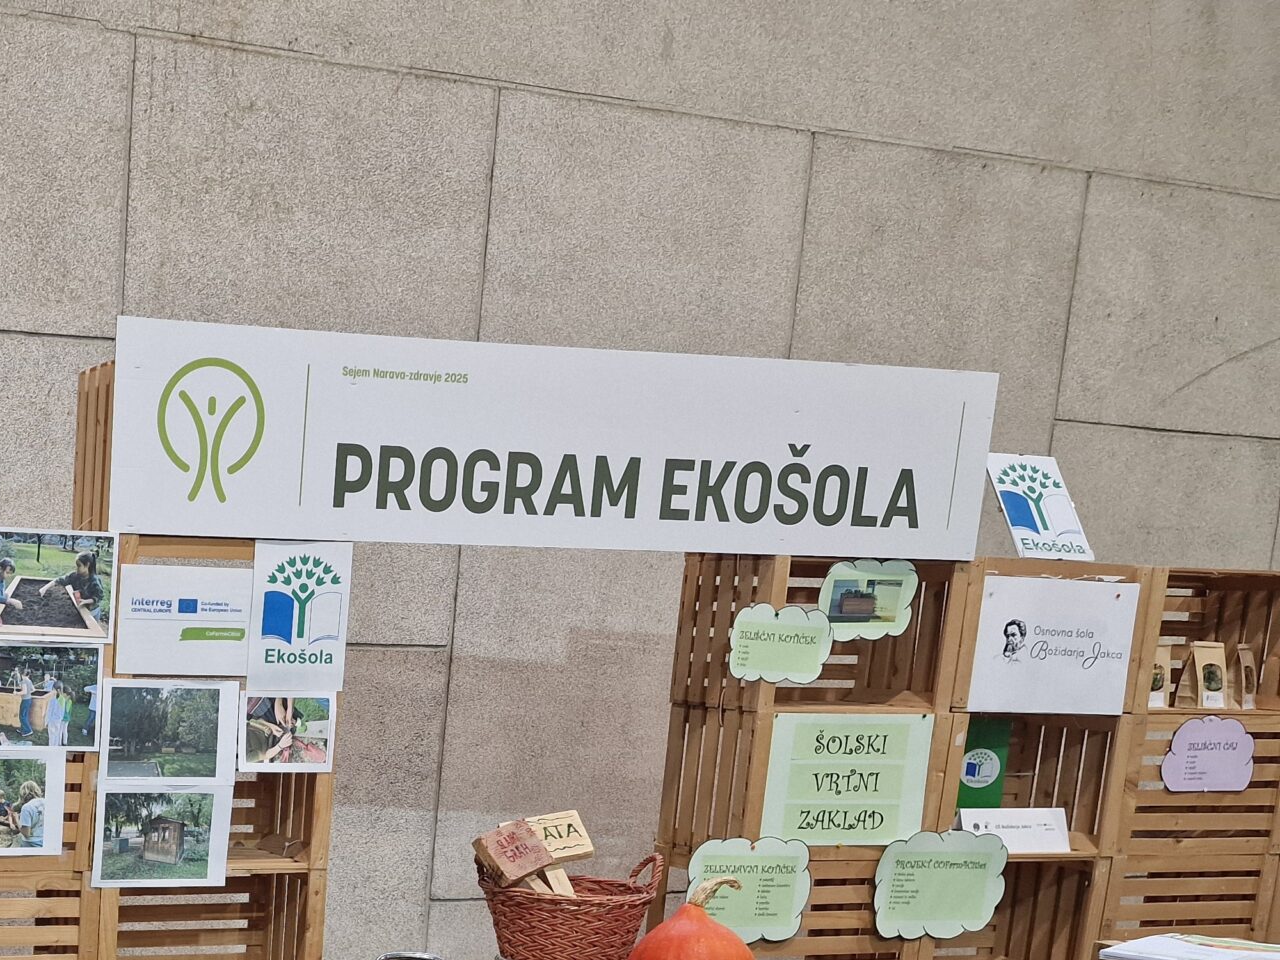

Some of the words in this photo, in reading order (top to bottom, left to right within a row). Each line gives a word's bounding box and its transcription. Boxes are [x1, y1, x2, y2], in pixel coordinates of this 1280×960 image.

[342, 366, 370, 379] Sejem
[373, 368, 442, 384] Narava-zdravje
[444, 372, 469, 384] 2025
[332, 442, 641, 519] PROGRAM
[659, 443, 920, 529] EKOŠOLA
[1020, 538, 1086, 554] Ekošola
[1034, 625, 1073, 638] Osnovna
[1075, 628, 1094, 639] šola
[265, 649, 333, 664] Ekošola
[1030, 640, 1085, 660] Božidarja
[1082, 642, 1123, 669] Jakca
[814, 729, 888, 755] ŠOLSKI
[812, 769, 880, 795] VRTNI
[797, 809, 884, 830] ZAKLAD
